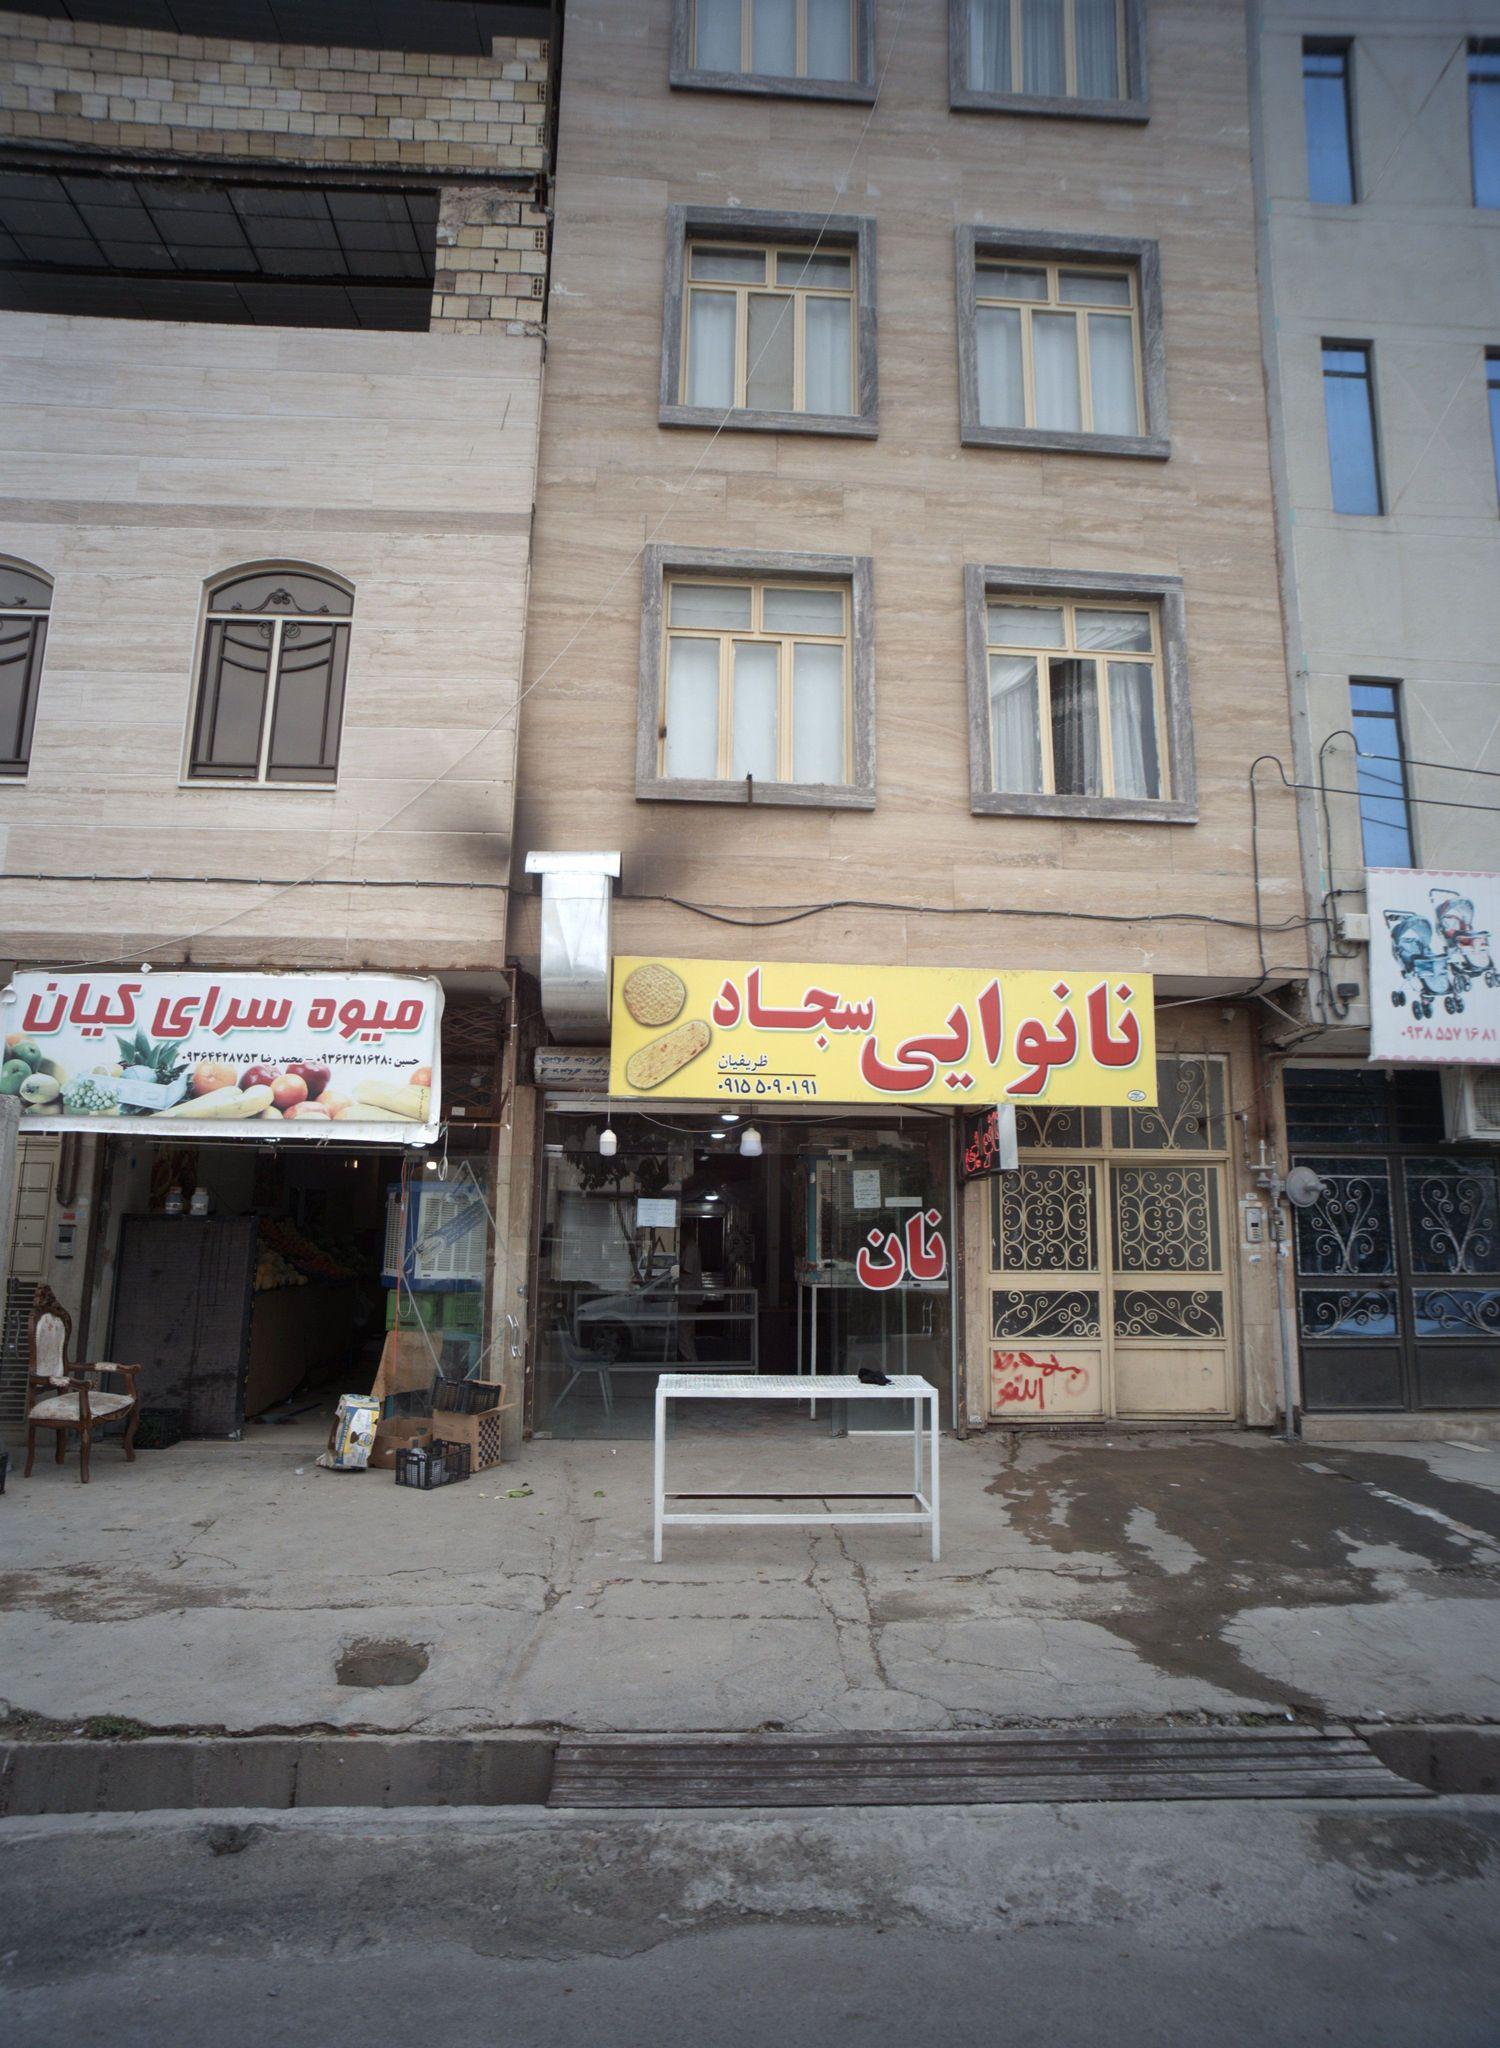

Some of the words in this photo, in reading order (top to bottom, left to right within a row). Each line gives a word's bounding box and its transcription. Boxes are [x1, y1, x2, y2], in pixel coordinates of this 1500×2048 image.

[22, 980, 142, 1037] کیان
[151, 985, 293, 1038] سرای
[307, 997, 425, 1042] میوه
[711, 968, 876, 1049] سجاد
[261, 1054, 277, 1066] رضا
[279, 1054, 303, 1064] محمد
[860, 977, 1142, 1095] نانوایی
[394, 1057, 420, 1068] حسین
[718, 1054, 768, 1071] ظریفیان
[856, 1208, 946, 1291] نان
